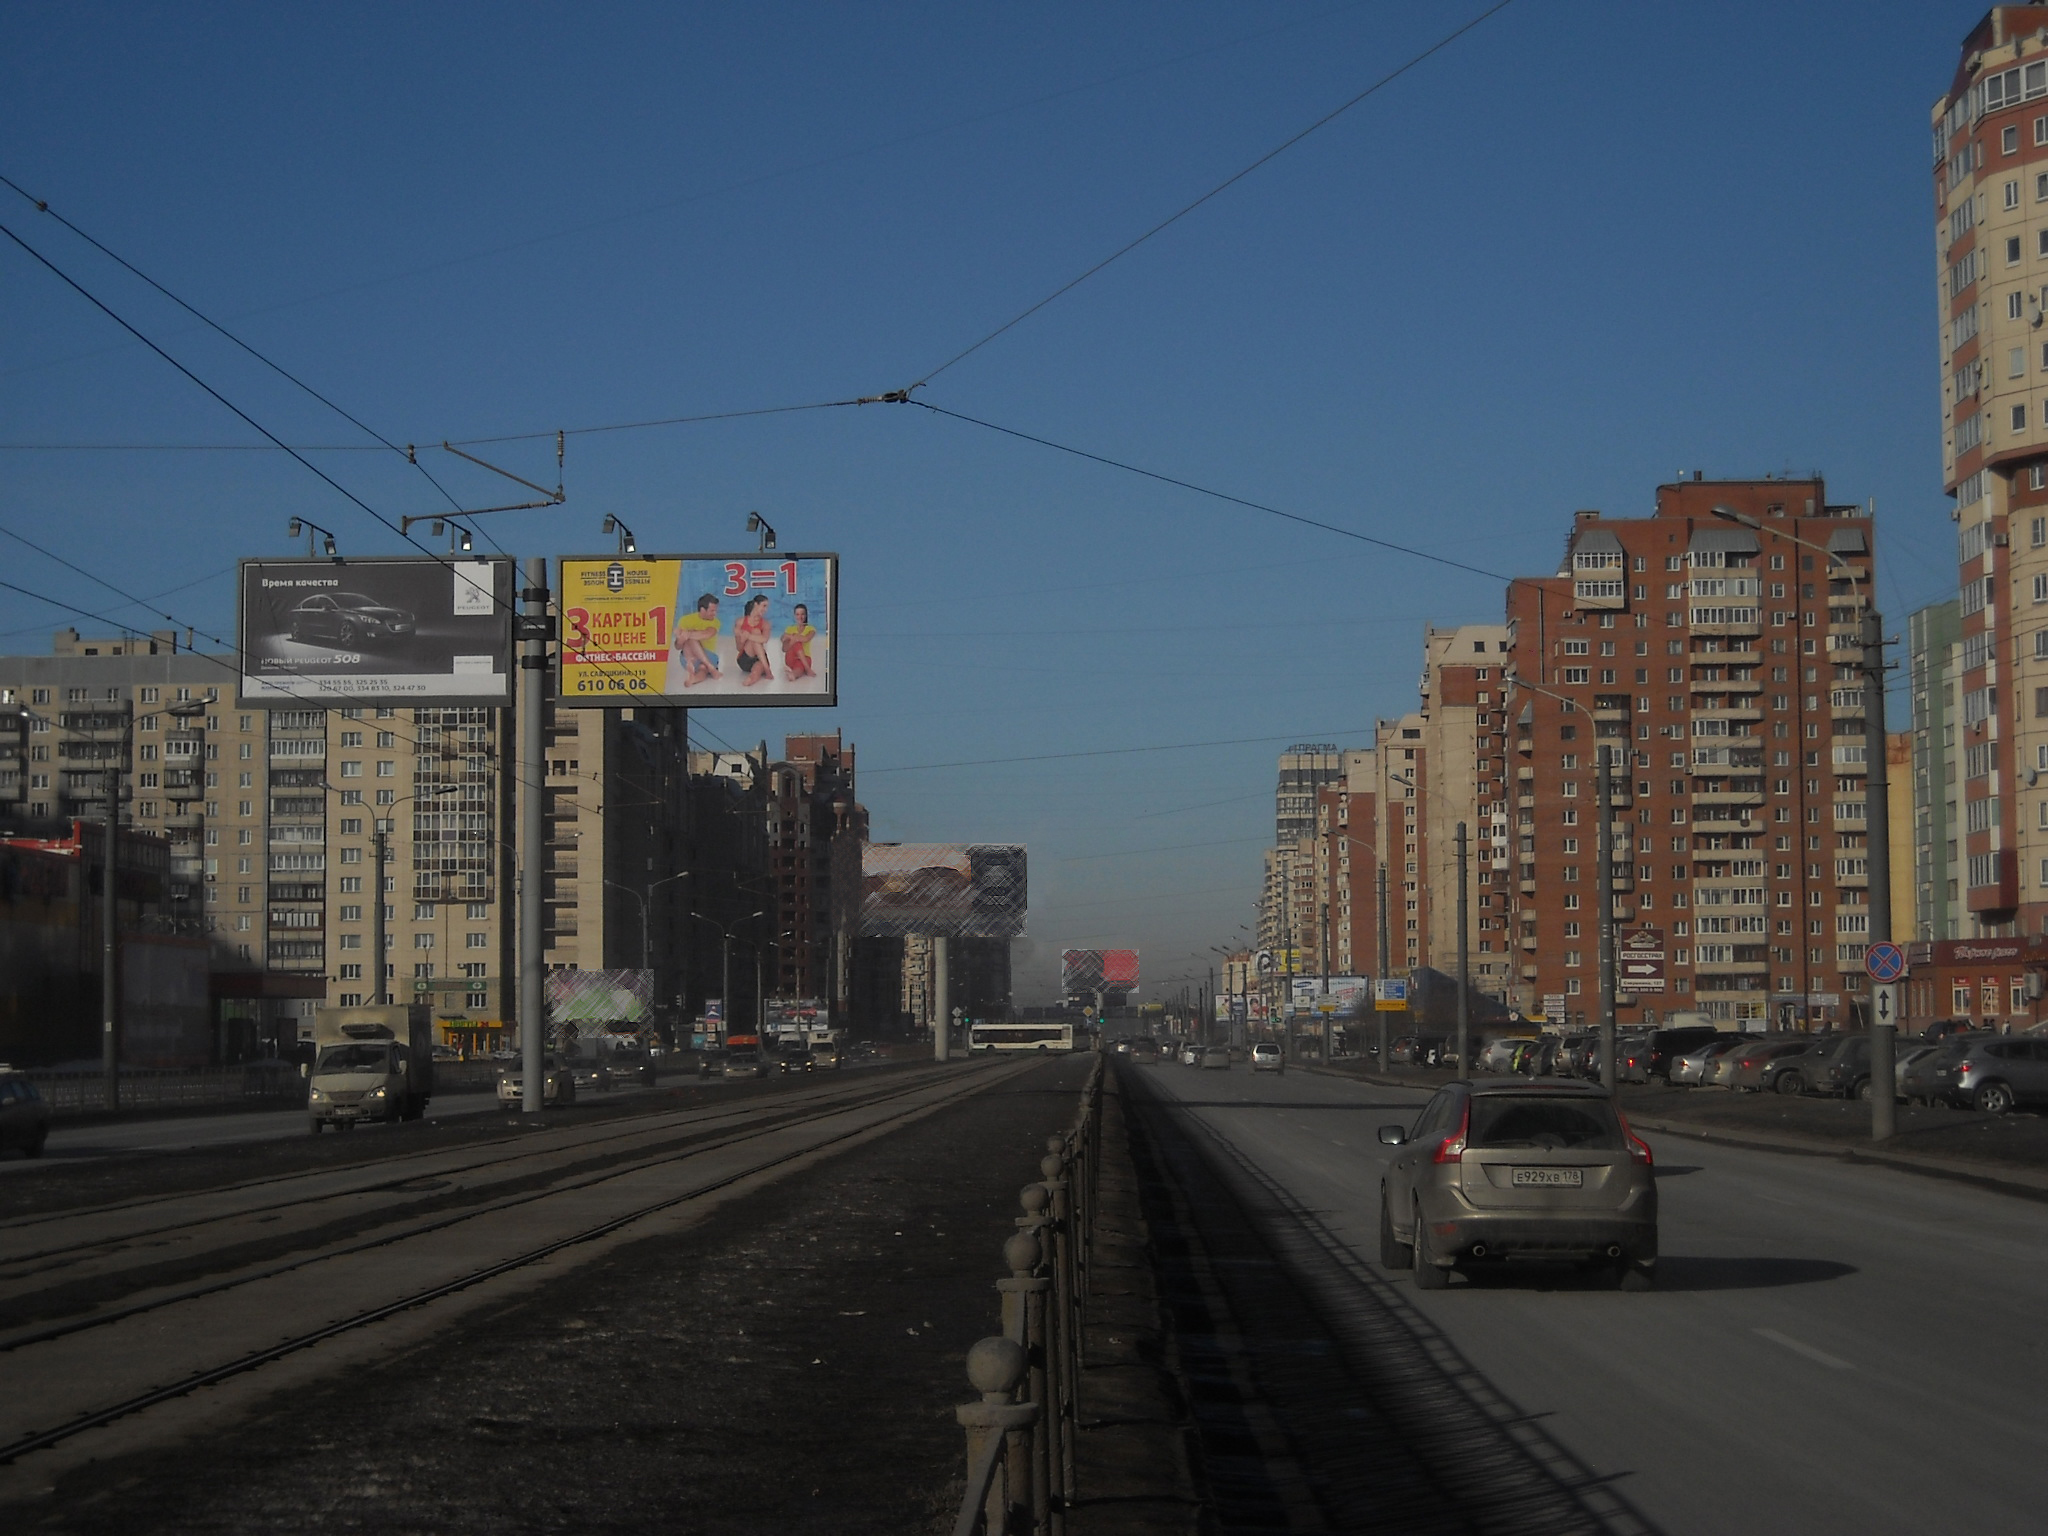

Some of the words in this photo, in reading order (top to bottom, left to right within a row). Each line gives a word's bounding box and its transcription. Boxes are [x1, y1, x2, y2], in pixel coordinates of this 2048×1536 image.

[262, 578, 293, 589] Время
[295, 579, 339, 587] качества
[724, 561, 797, 597] 3=1
[566, 606, 591, 648] 3
[593, 612, 646, 628] КАРТЫ
[648, 605, 666, 645] 1
[593, 633, 611, 645] ПО
[613, 632, 647, 647] ЦЕНЕ
[333, 654, 361, 664] 508
[577, 680, 604, 692] 610
[608, 679, 625, 690] 06
[629, 678, 647, 690] 06
